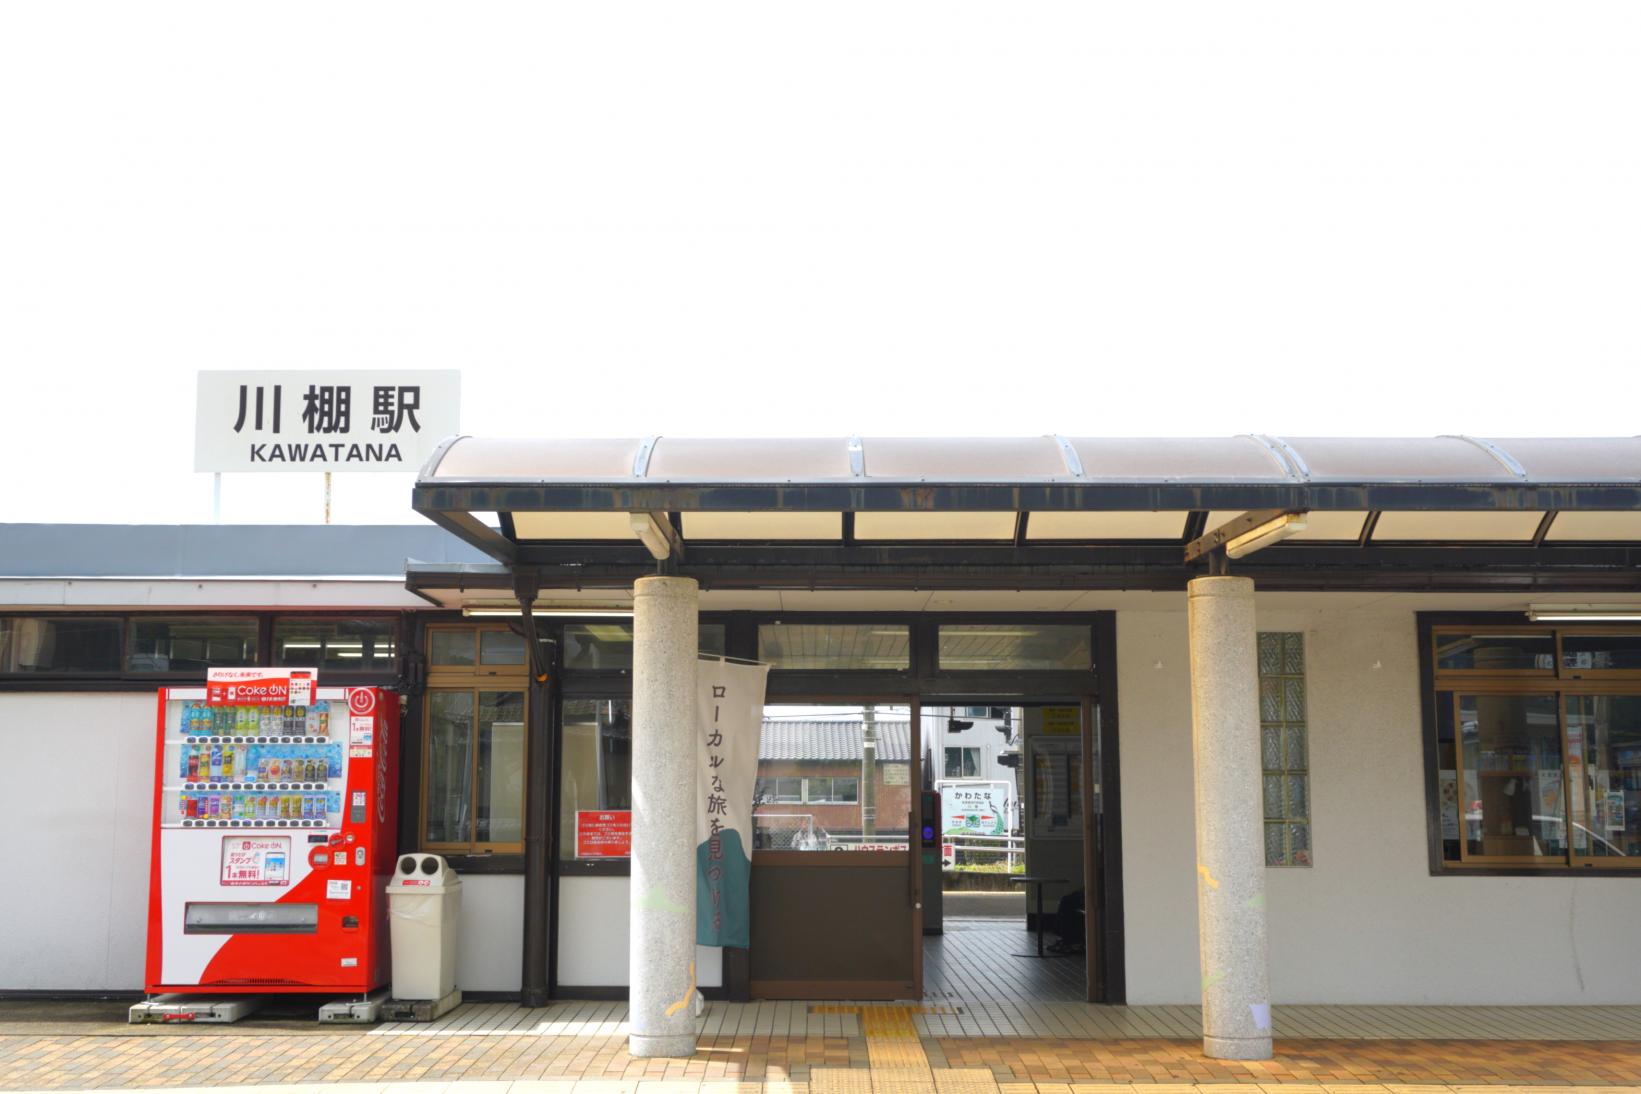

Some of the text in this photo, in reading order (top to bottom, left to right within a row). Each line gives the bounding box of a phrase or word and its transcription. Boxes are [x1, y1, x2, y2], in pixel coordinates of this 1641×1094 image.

[233, 385, 421, 434] 川棚駅
[250, 443, 403, 462] KAWATANA
[237, 685, 267, 695] Coke
[954, 791, 992, 800] かわたな
